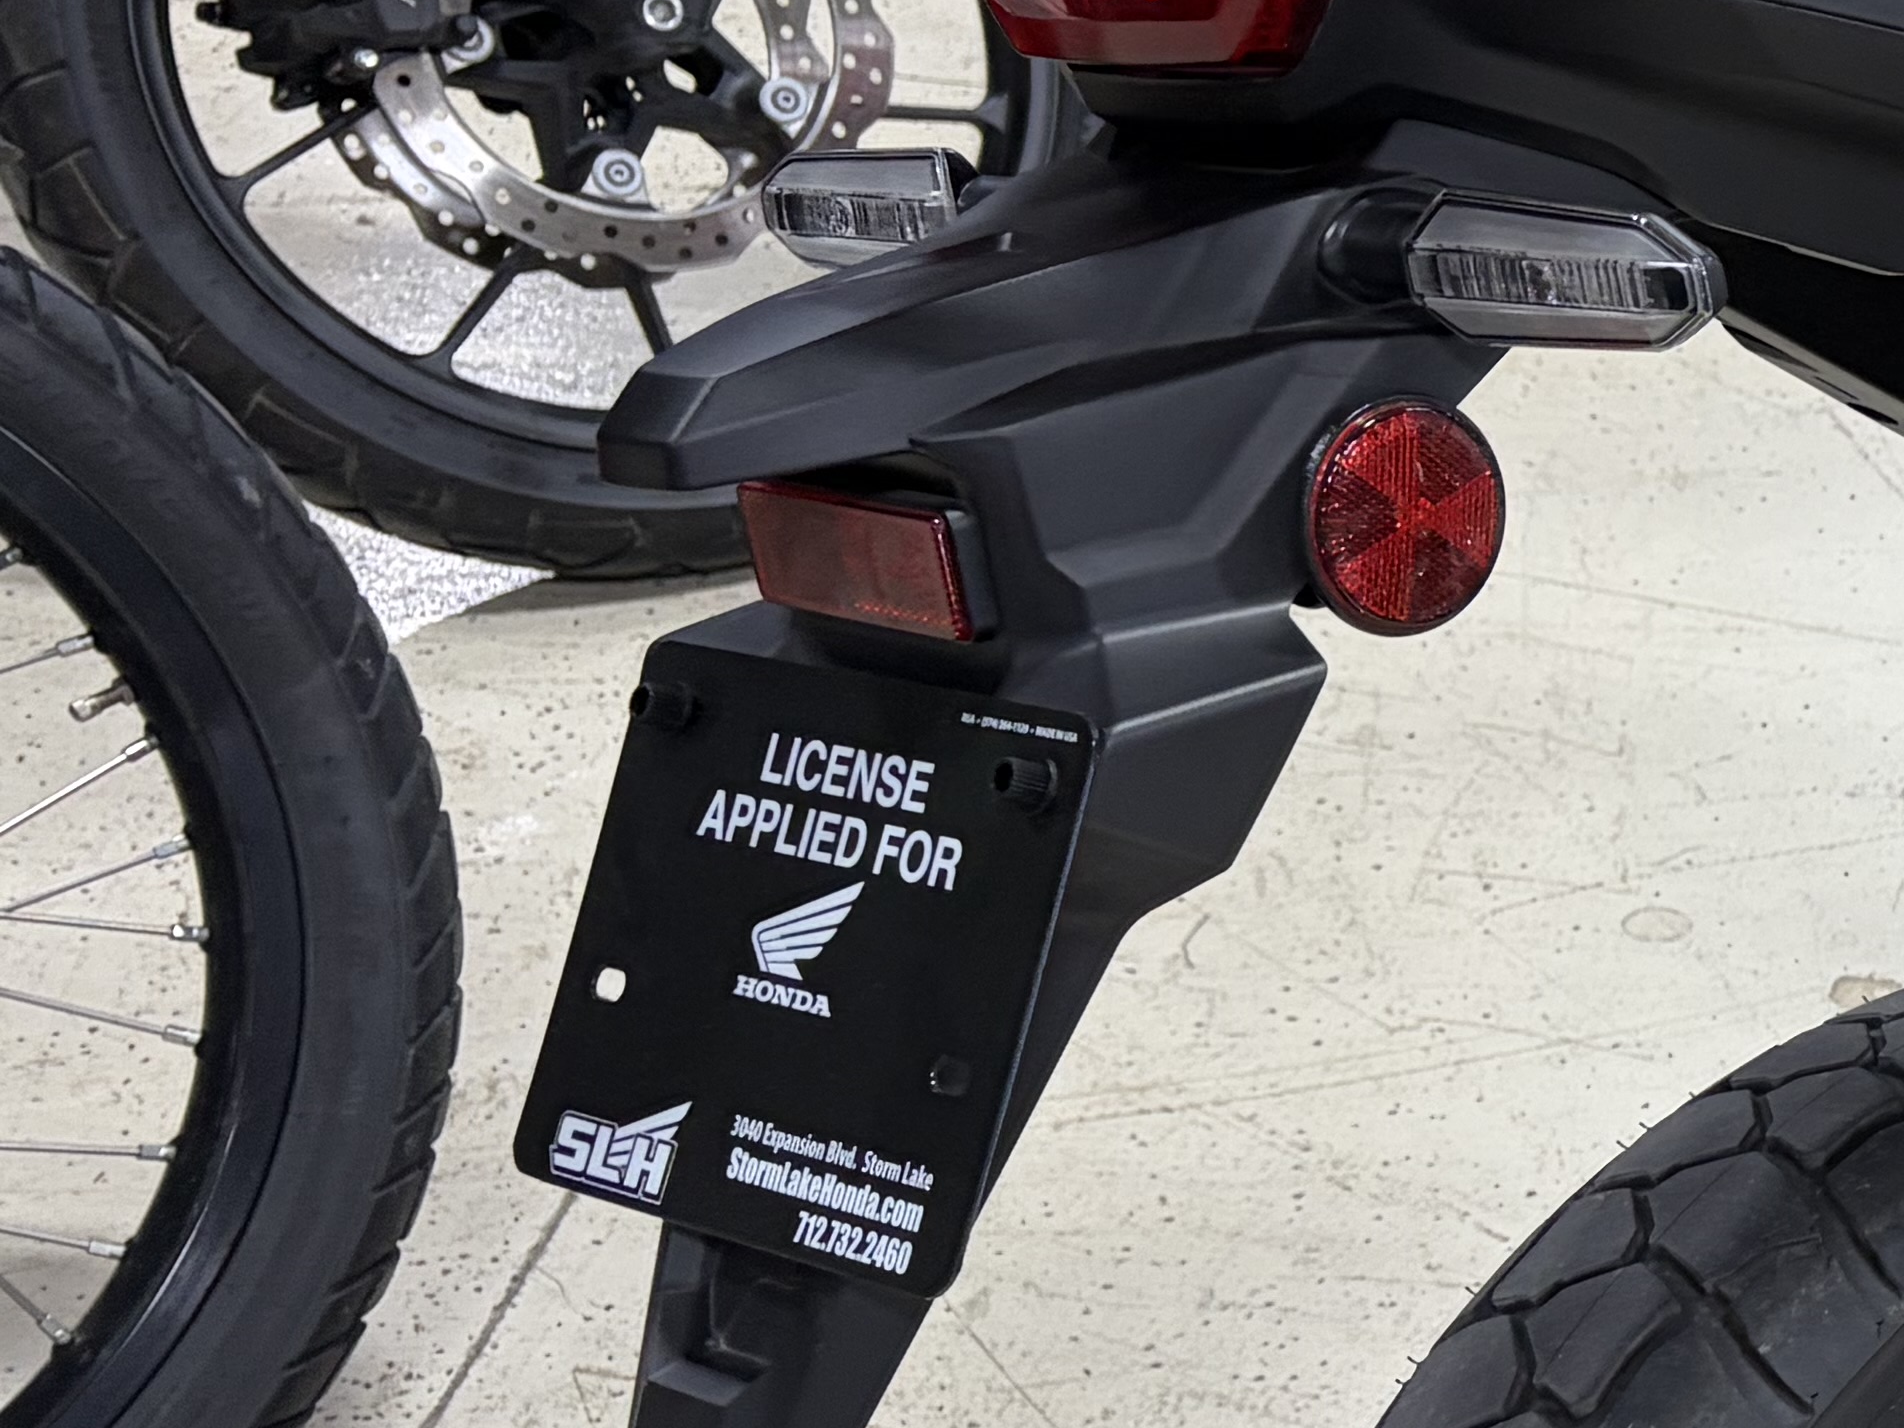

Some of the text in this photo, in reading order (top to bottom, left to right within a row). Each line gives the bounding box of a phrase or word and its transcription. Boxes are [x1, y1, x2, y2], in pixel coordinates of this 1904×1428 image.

[759, 732, 936, 814] LICENSE
[695, 789, 963, 891] APPLIED FOR
[731, 974, 832, 1018] HONDA
[726, 1146, 925, 1233] StormLakeHonda.com
[730, 1114, 934, 1192] 3040 Expansion Blvd. Storm Lake
[792, 1210, 914, 1275] 712.732.2460
